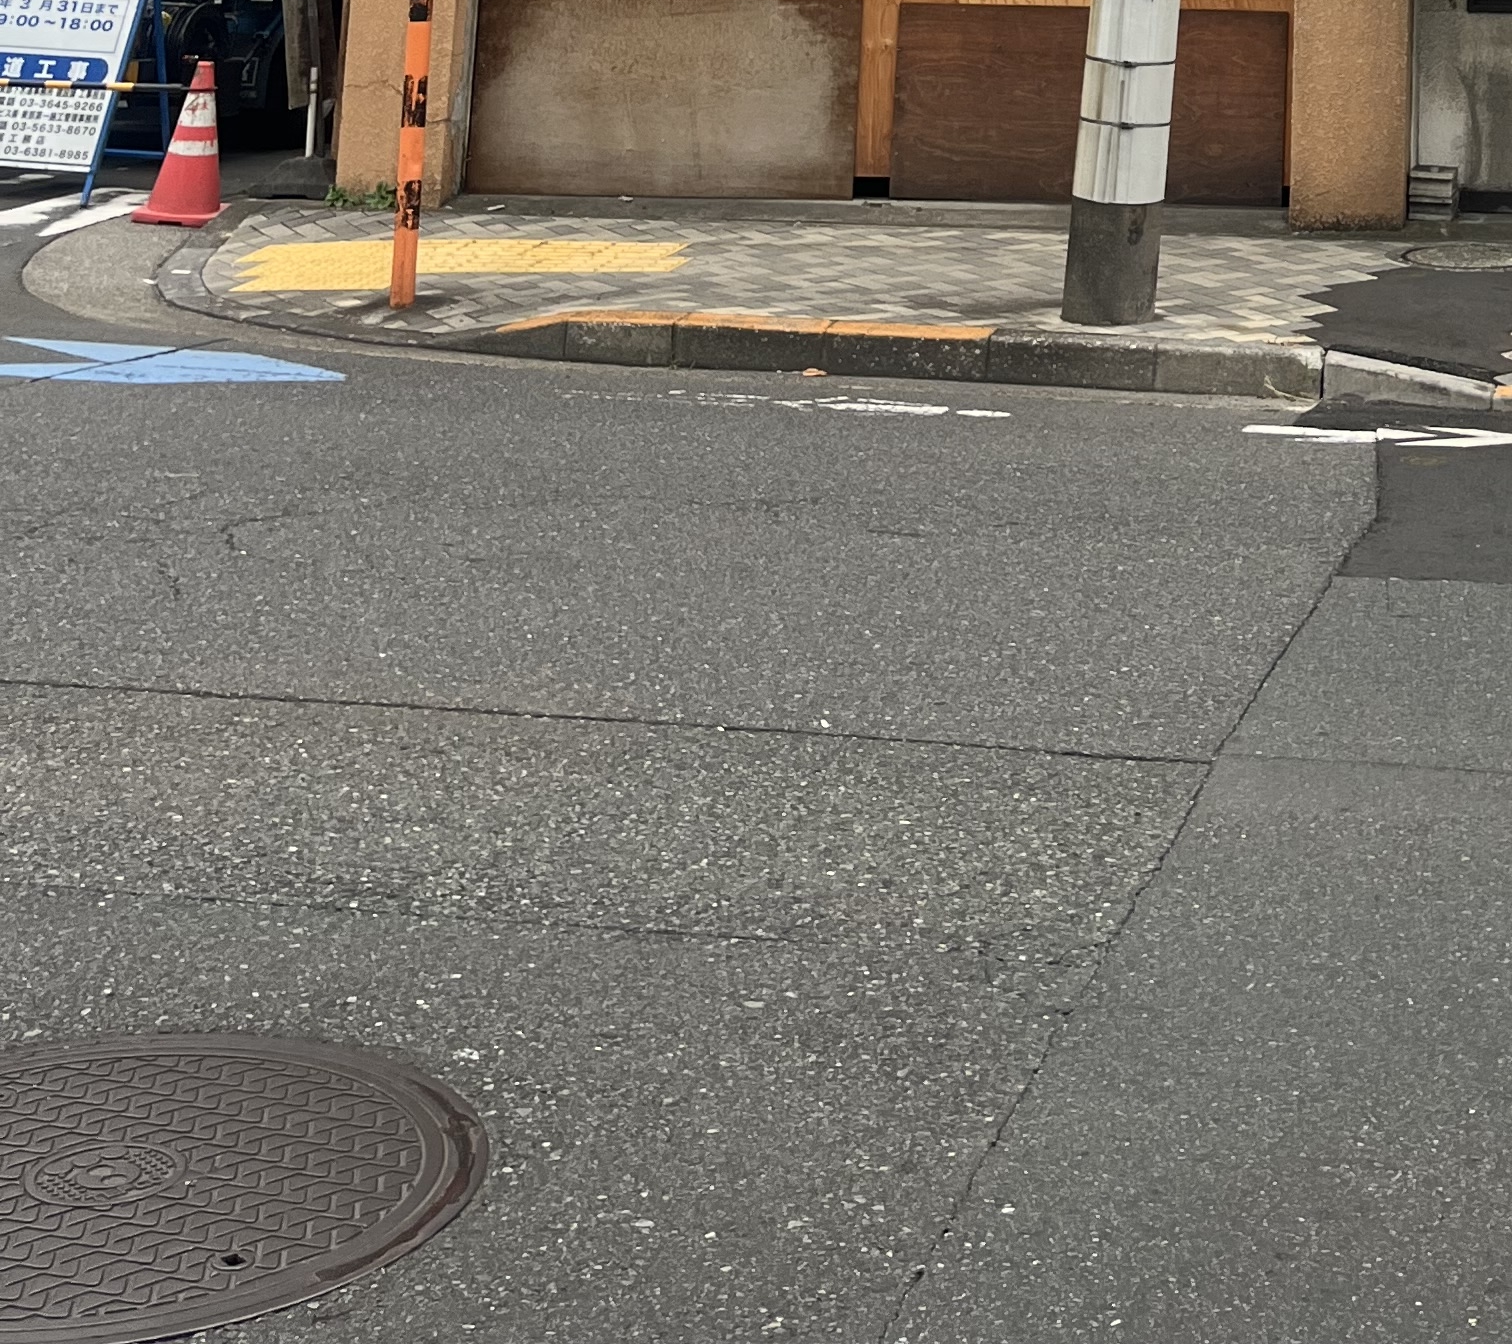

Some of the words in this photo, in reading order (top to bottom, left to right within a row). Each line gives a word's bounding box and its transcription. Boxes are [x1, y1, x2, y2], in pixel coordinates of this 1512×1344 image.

[20, 98, 104, 112] 03-3645-9266
[12, 122, 97, 137] 03-5633-8670
[4, 146, 89, 161] 03-6381-8985
